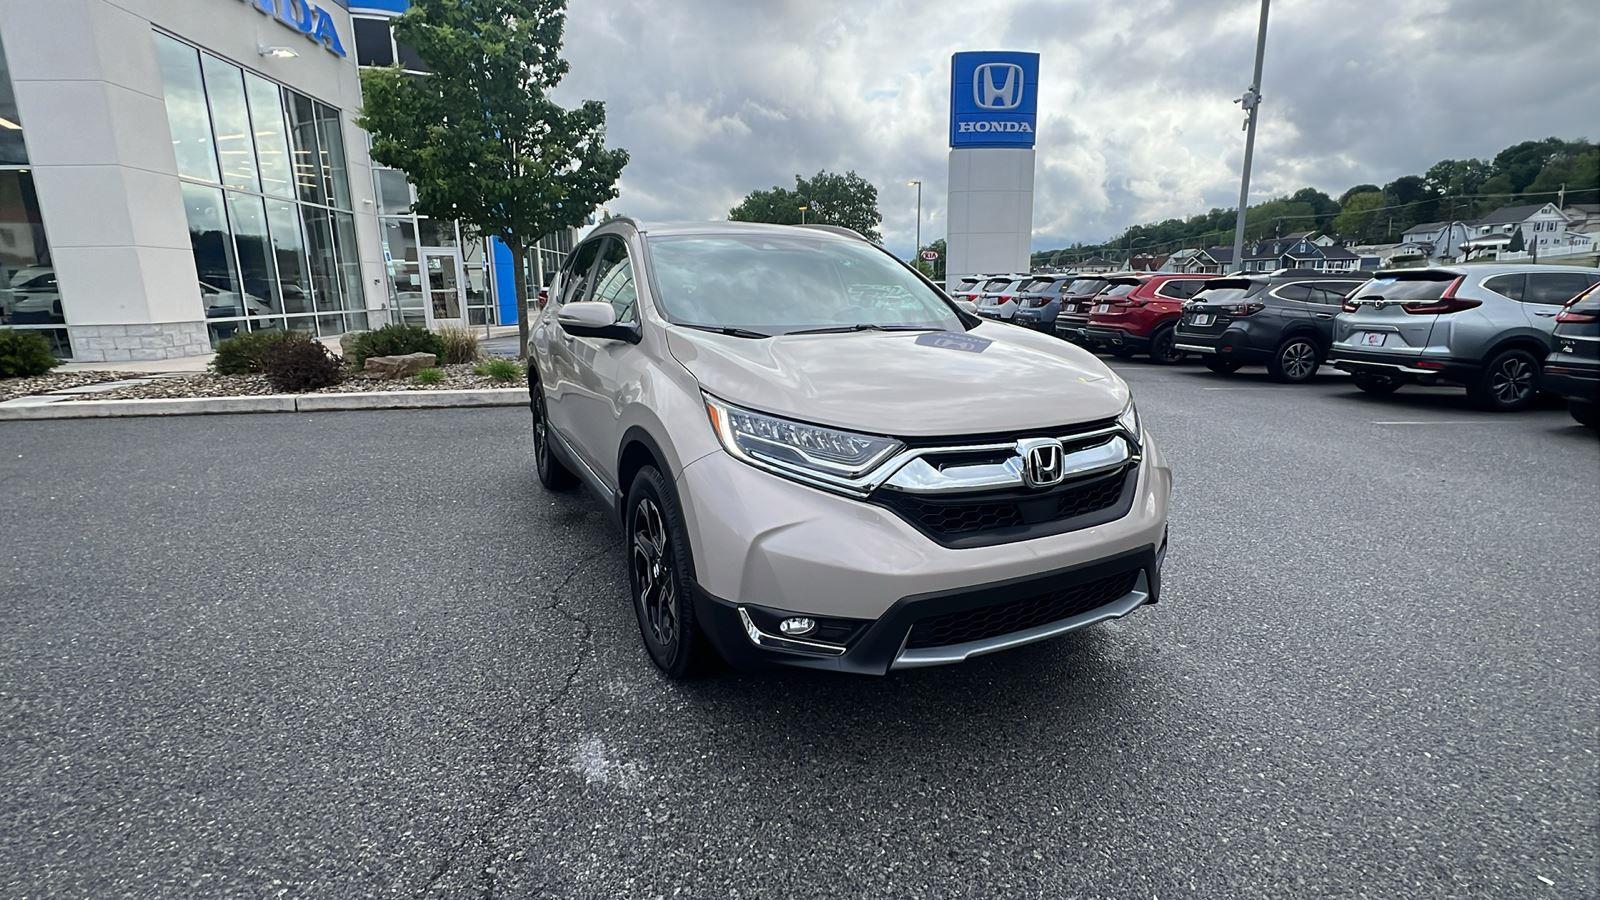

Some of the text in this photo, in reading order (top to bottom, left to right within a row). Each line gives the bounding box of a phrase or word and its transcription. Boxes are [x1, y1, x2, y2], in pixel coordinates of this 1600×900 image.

[252, 0, 347, 57] DA
[958, 121, 1034, 133] HONDA
[924, 251, 937, 259] KIA
